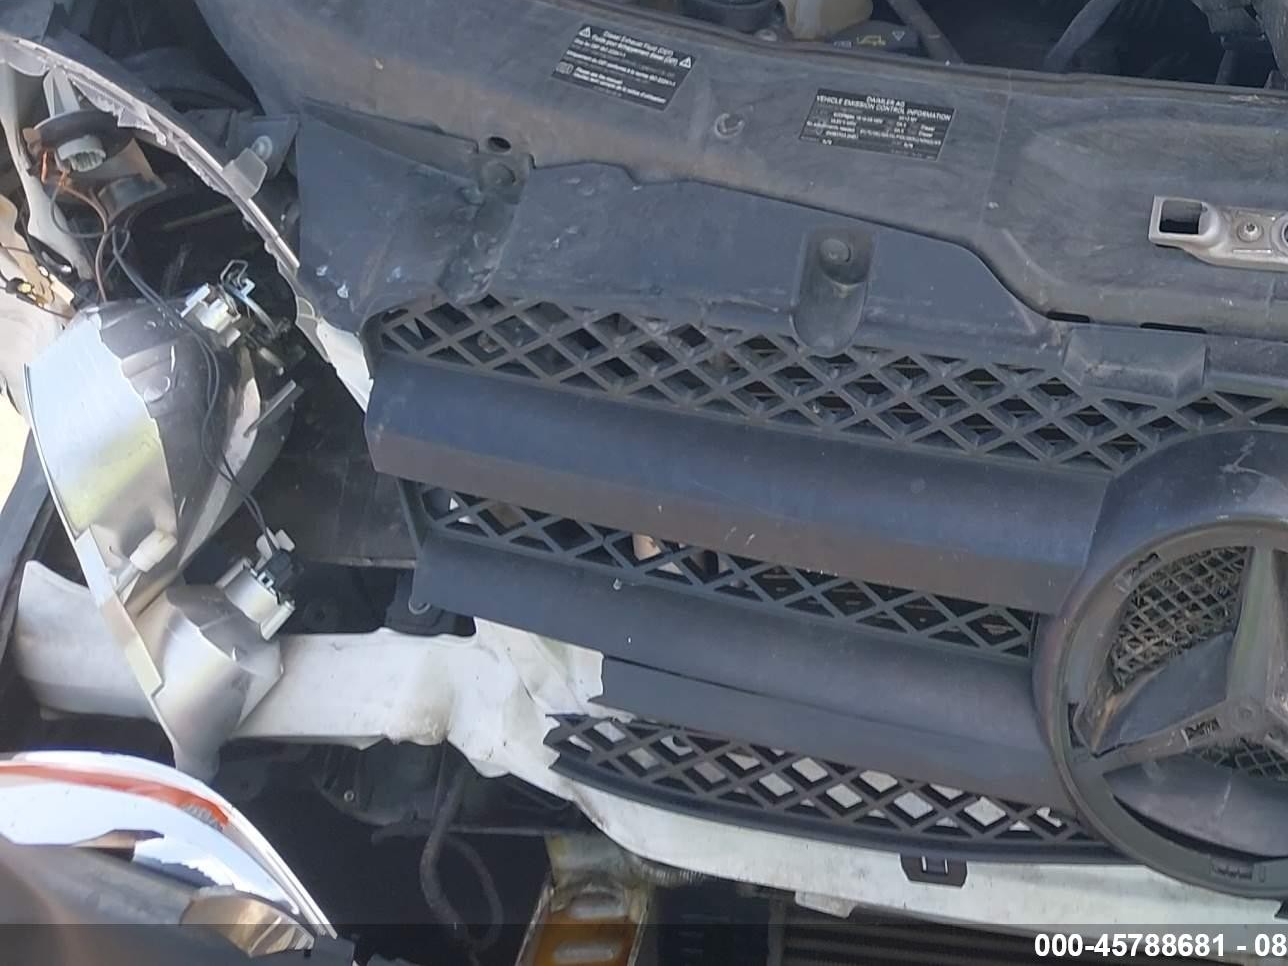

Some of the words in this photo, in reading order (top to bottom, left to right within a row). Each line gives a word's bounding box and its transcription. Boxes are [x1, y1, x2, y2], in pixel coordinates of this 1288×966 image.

[816, 95, 844, 106] VEHICLE
[843, 98, 876, 111] EMISSION
[876, 103, 905, 116] CONTROL
[906, 108, 952, 122] INFORMATION
